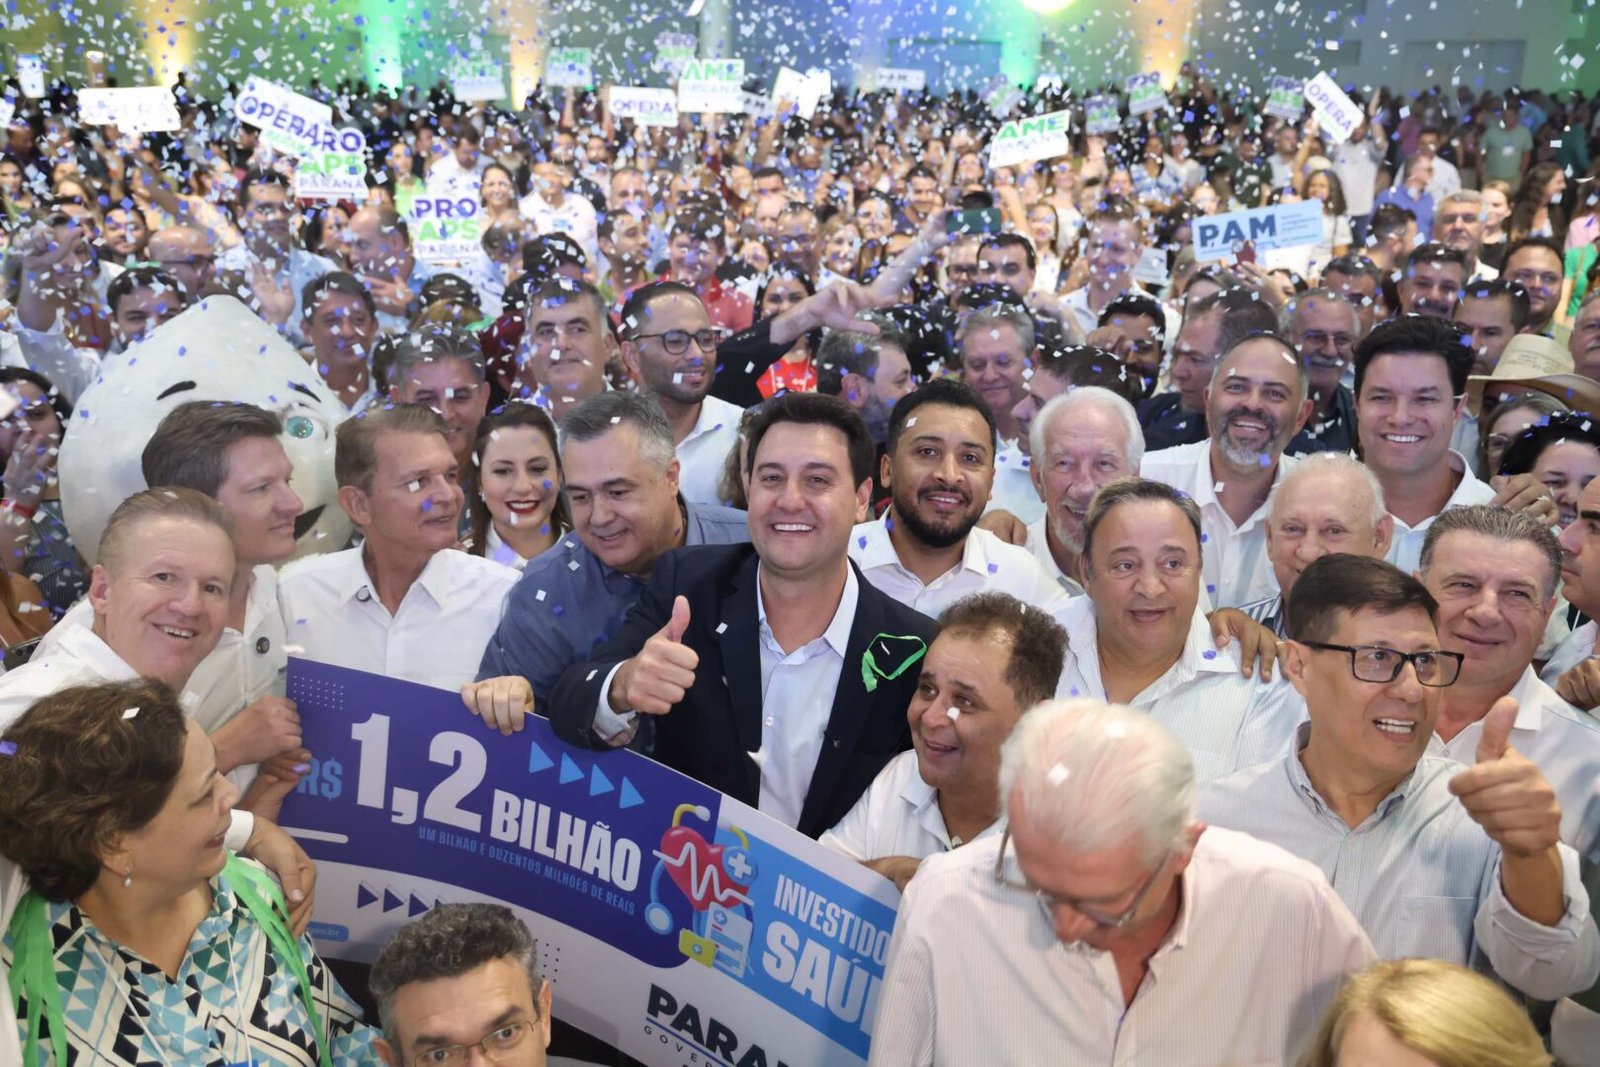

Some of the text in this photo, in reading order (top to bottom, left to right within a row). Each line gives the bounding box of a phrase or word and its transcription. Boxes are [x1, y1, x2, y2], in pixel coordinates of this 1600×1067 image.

[683, 63, 740, 81] AME
[241, 96, 320, 147] OPERA
[1309, 84, 1352, 132] OPERA
[999, 114, 1066, 139] AME
[300, 153, 363, 175] APS
[415, 198, 477, 218] PRO
[419, 219, 479, 241] APS
[1198, 214, 1277, 248] PAM
[351, 713, 487, 833] 1,2
[490, 789, 642, 892] BILHÃO
[419, 826, 436, 842] UM
[480, 842, 487, 857] E
[489, 845, 541, 876] DUZENTOS
[591, 884, 603, 901] DE
[606, 891, 635, 916] REAIS
[647, 983, 789, 1067] PARA
